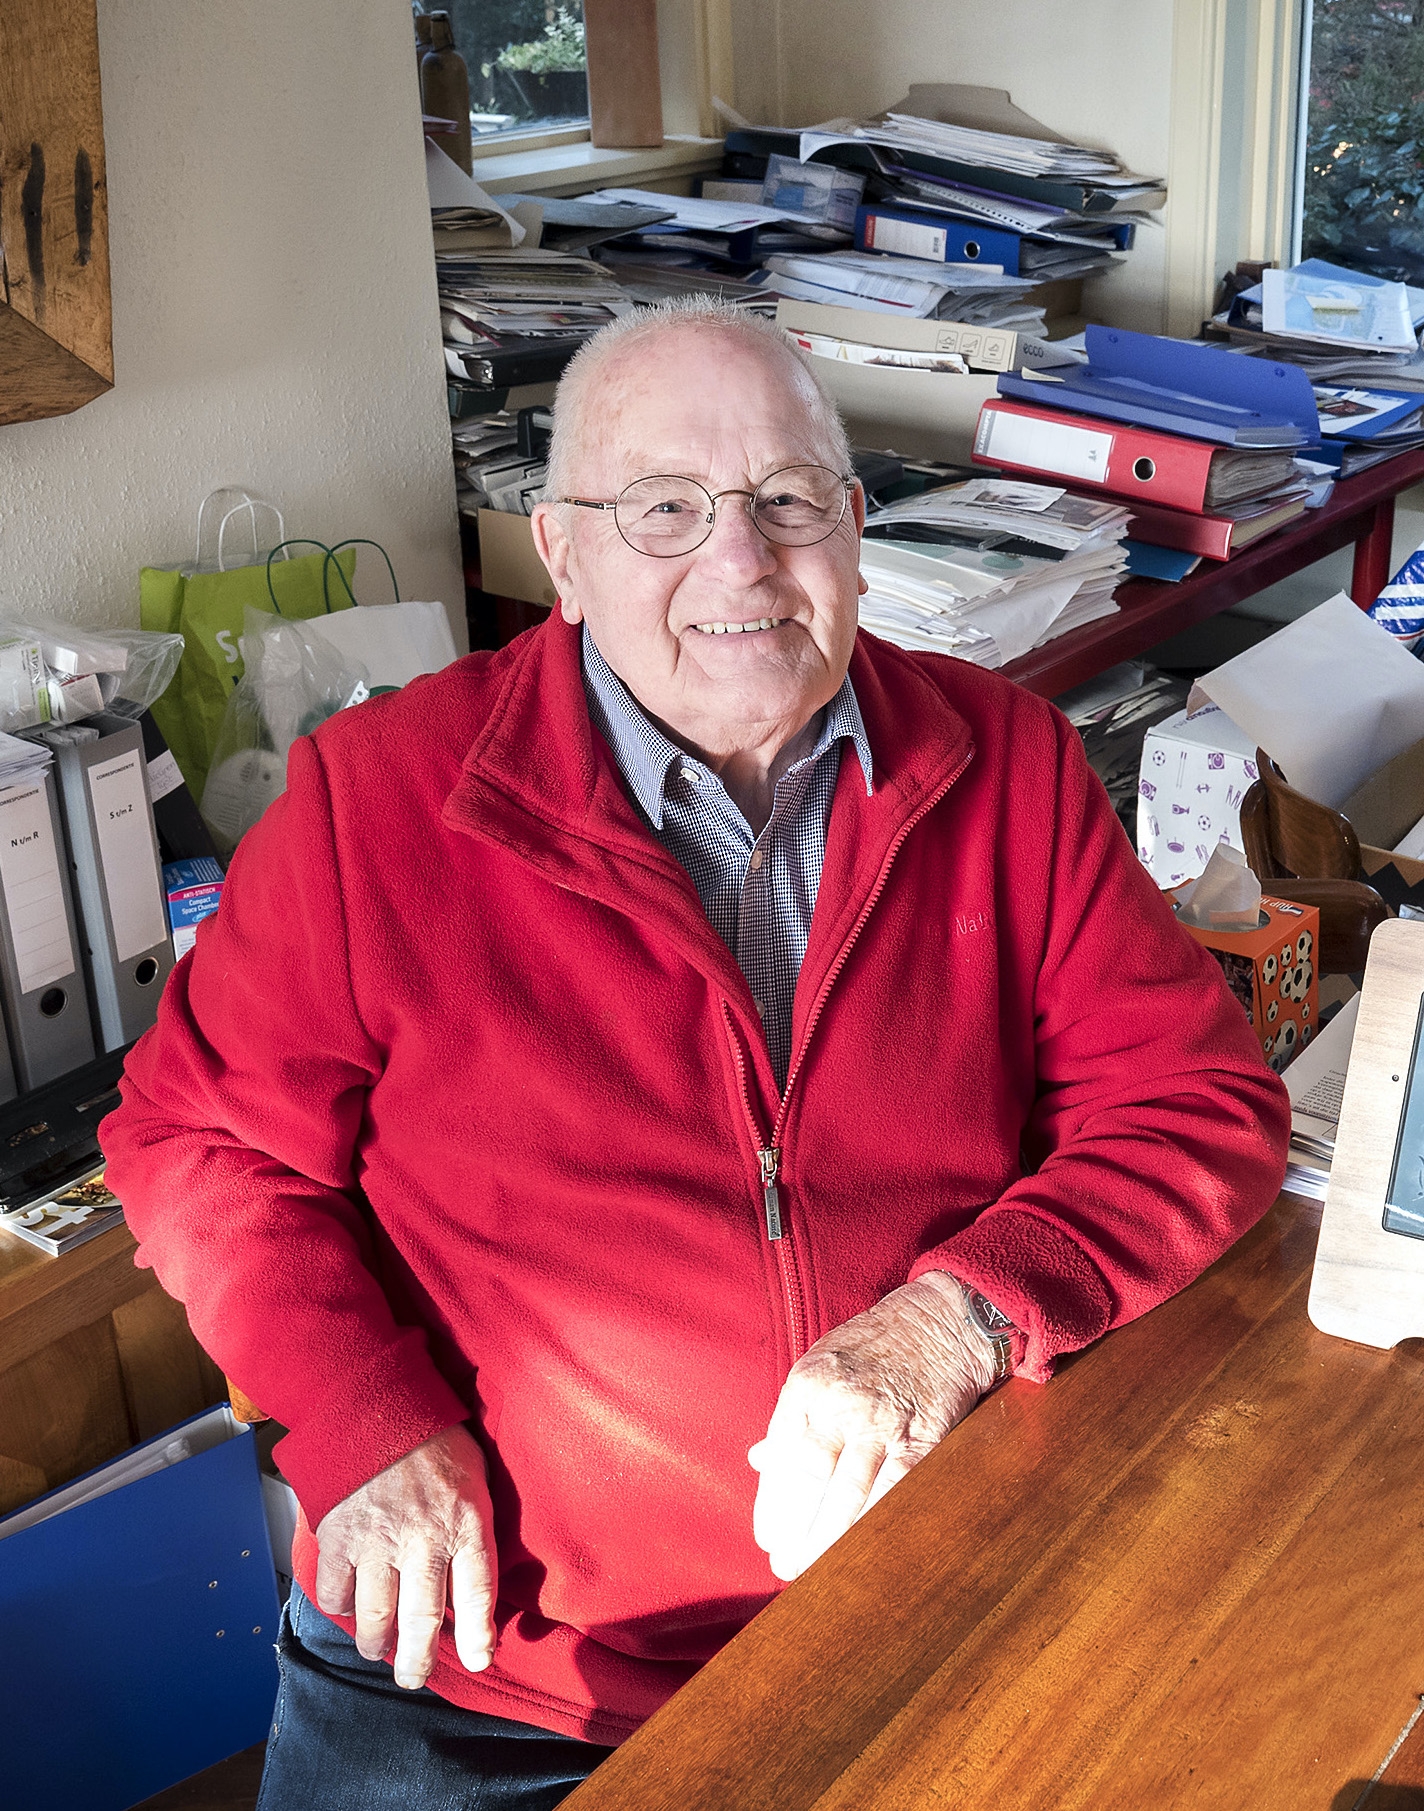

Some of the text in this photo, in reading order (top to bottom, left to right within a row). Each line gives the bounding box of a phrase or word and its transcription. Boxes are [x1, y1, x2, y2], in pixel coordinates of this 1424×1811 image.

[1023, 343, 1044, 358] ecco
[96, 762, 135, 781] CORRESPONDENTIE
[0, 788, 39, 806] ORRESPONDENTIE
[109, 803, 134, 820] S t/m Z
[10, 831, 40, 848] N t/m R
[182, 901, 220, 915] Space Chambe
[189, 896, 211, 907] Compact
